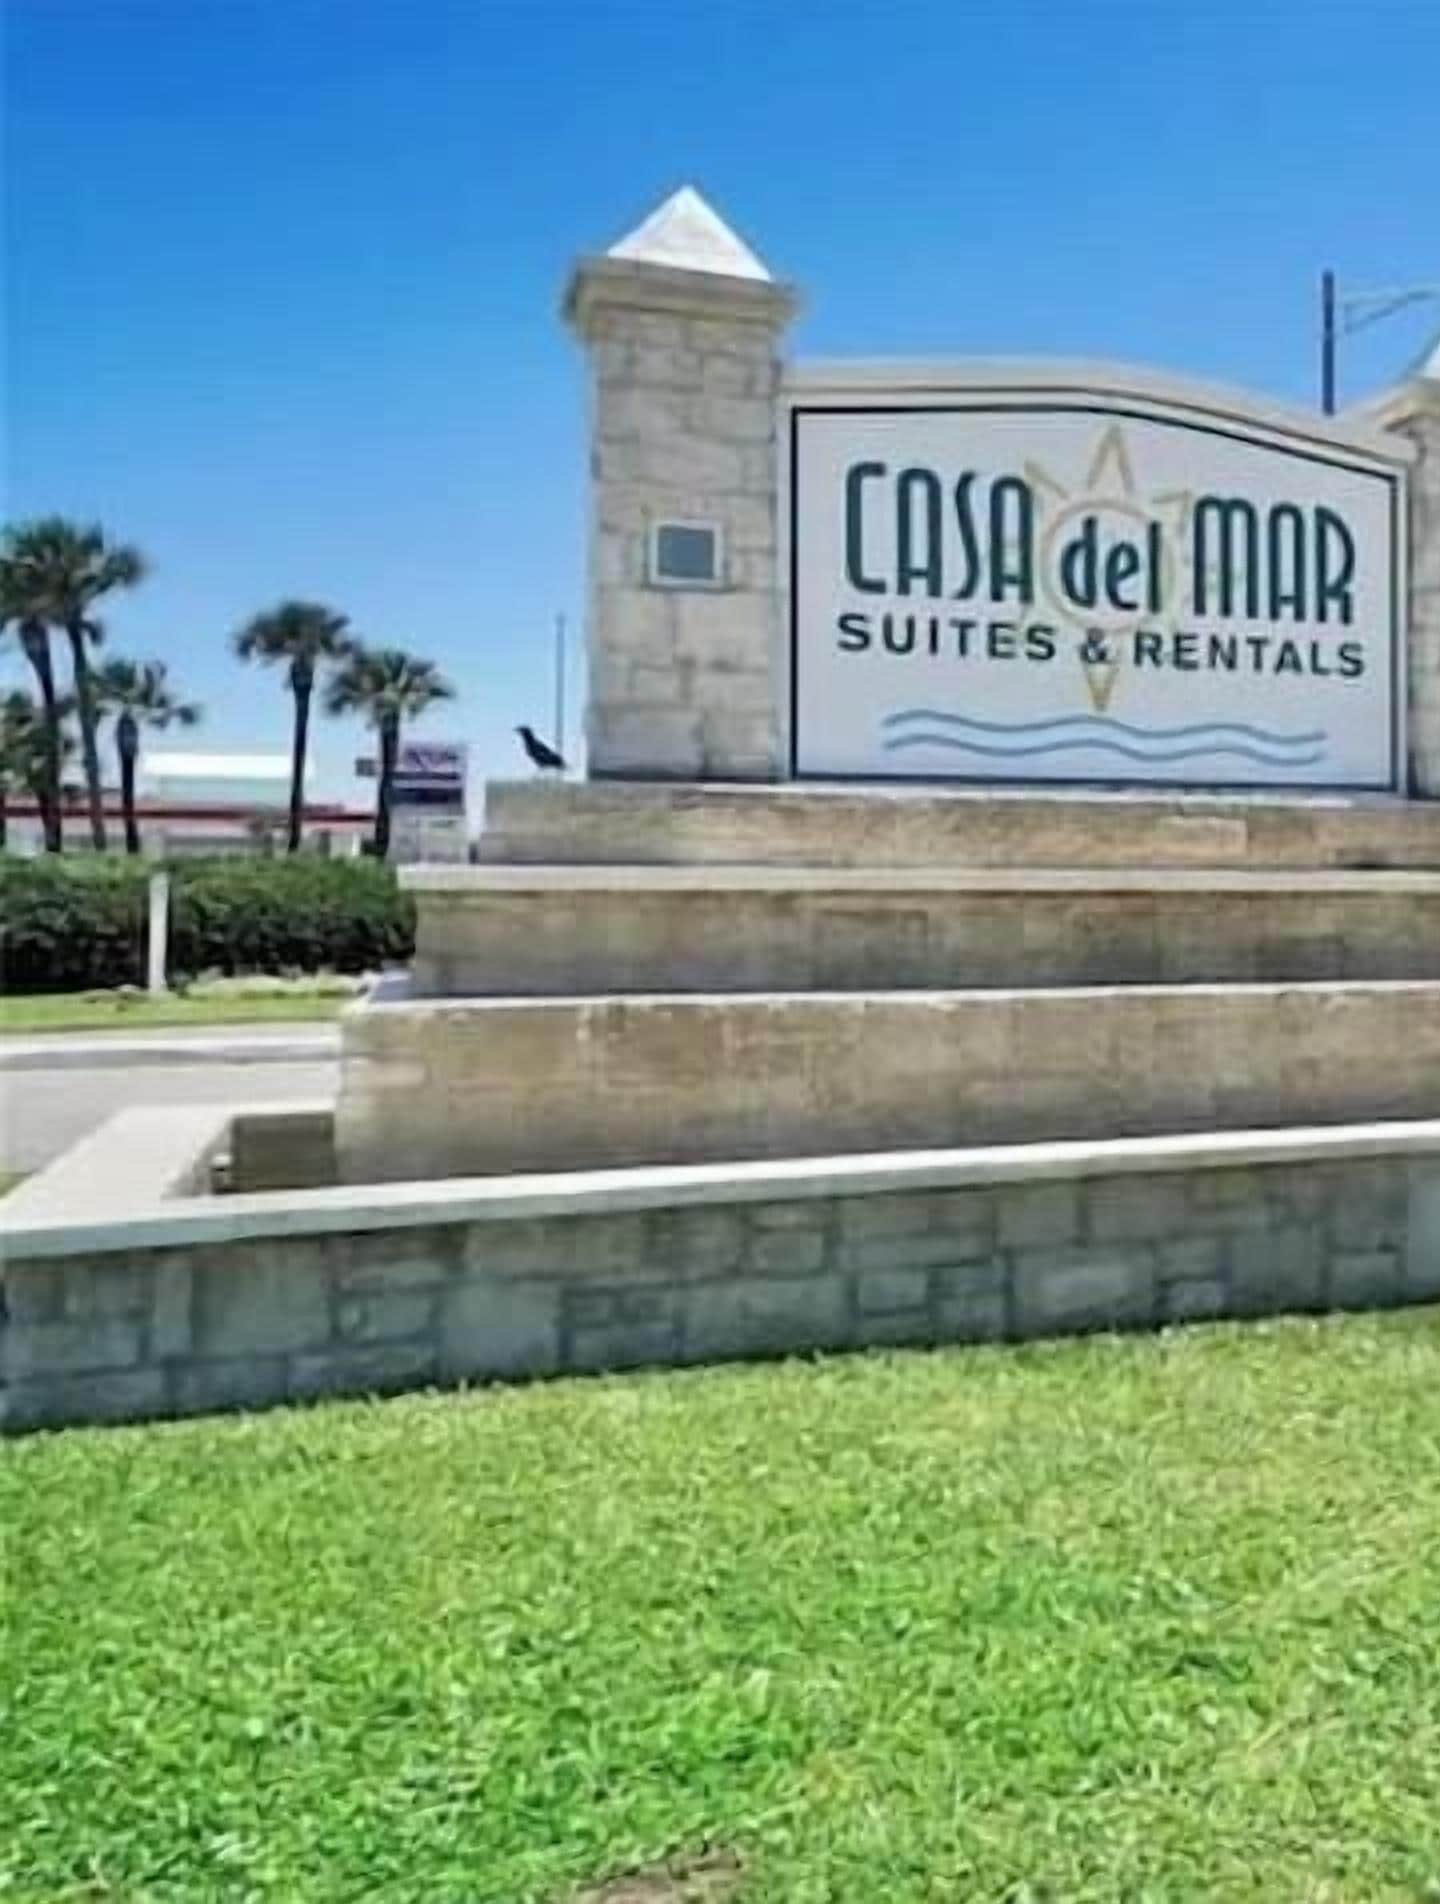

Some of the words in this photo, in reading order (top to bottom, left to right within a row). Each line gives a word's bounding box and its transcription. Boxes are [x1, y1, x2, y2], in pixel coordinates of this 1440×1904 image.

[845, 461, 1034, 603] CASA
[1061, 515, 1162, 614] del
[1193, 495, 1356, 625] MAR
[836, 612, 1057, 661] SUITES
[1079, 628, 1109, 664] &
[1133, 631, 1365, 677] RENTALS
